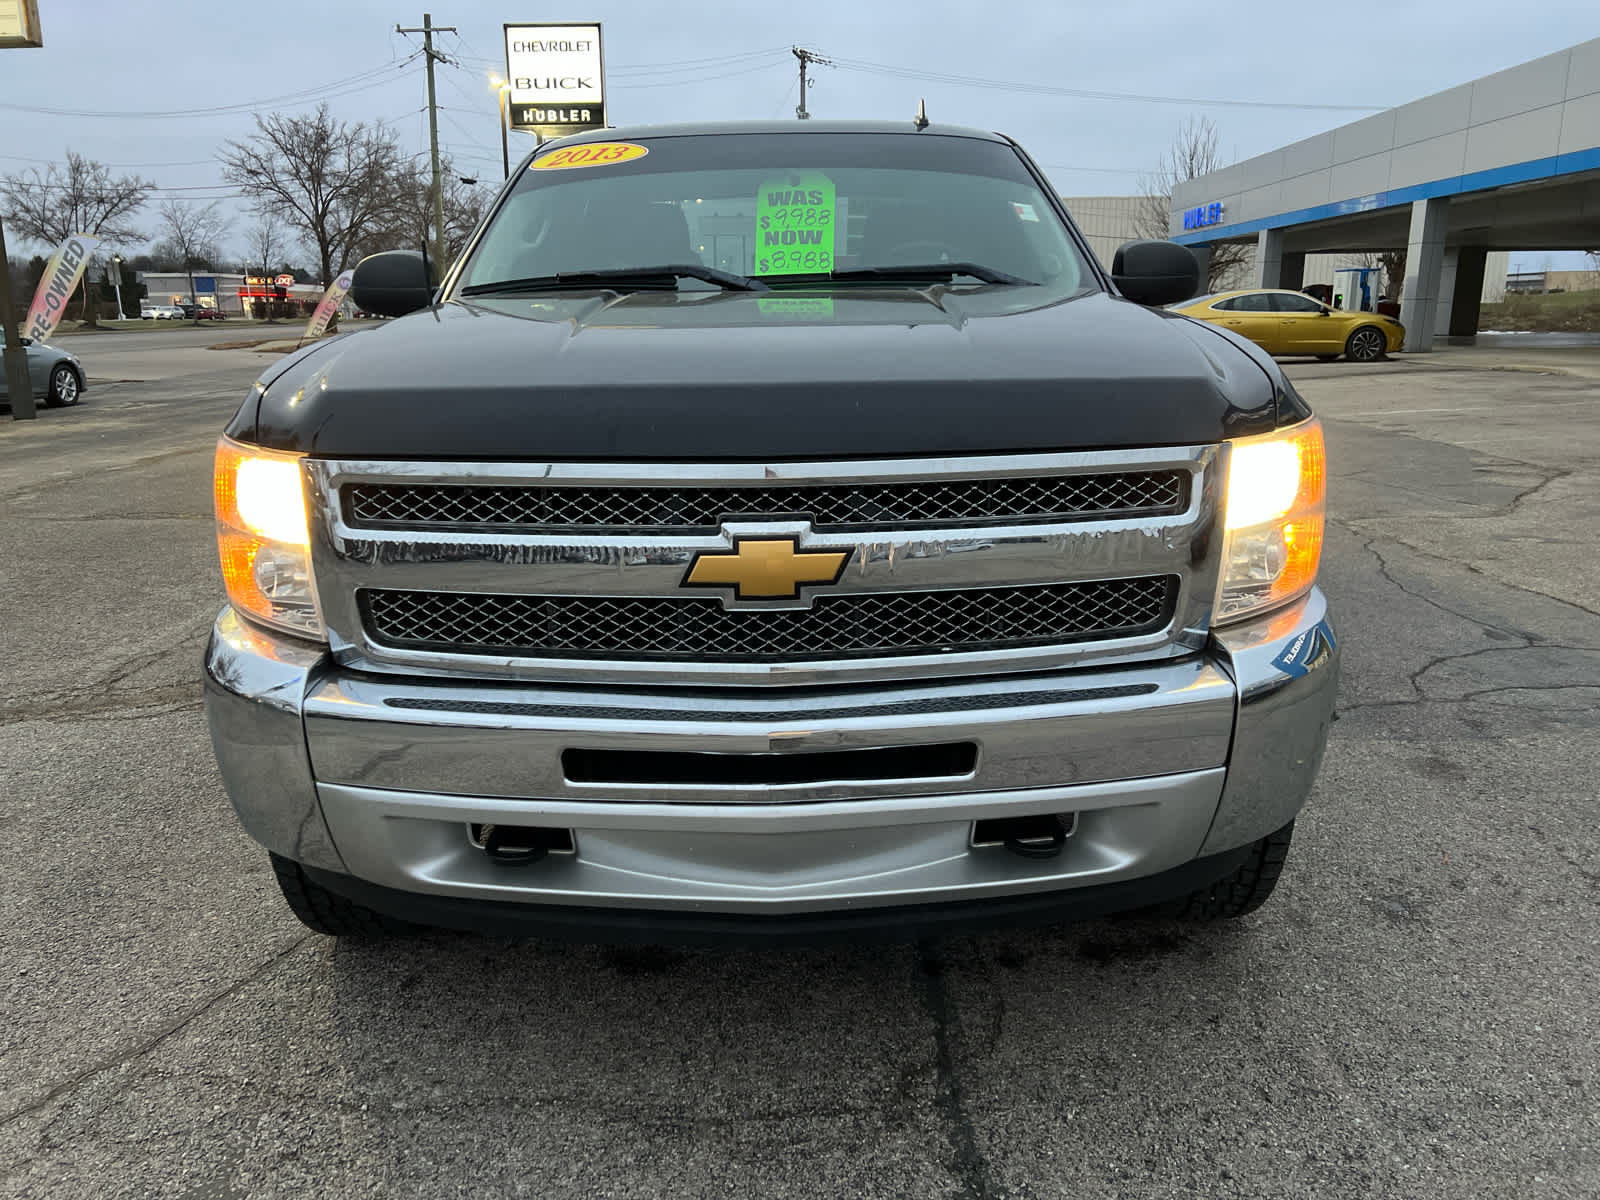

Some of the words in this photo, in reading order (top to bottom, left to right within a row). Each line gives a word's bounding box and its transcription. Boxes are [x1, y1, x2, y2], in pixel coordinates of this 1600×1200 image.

[513, 40, 592, 52] CHEVROLET
[515, 77, 593, 89] BUICK
[523, 109, 591, 122] HUBLER
[547, 146, 629, 167] 2013
[768, 190, 824, 207] WAS
[764, 230, 823, 246] NOW
[30, 240, 85, 343] RE-OWNED
